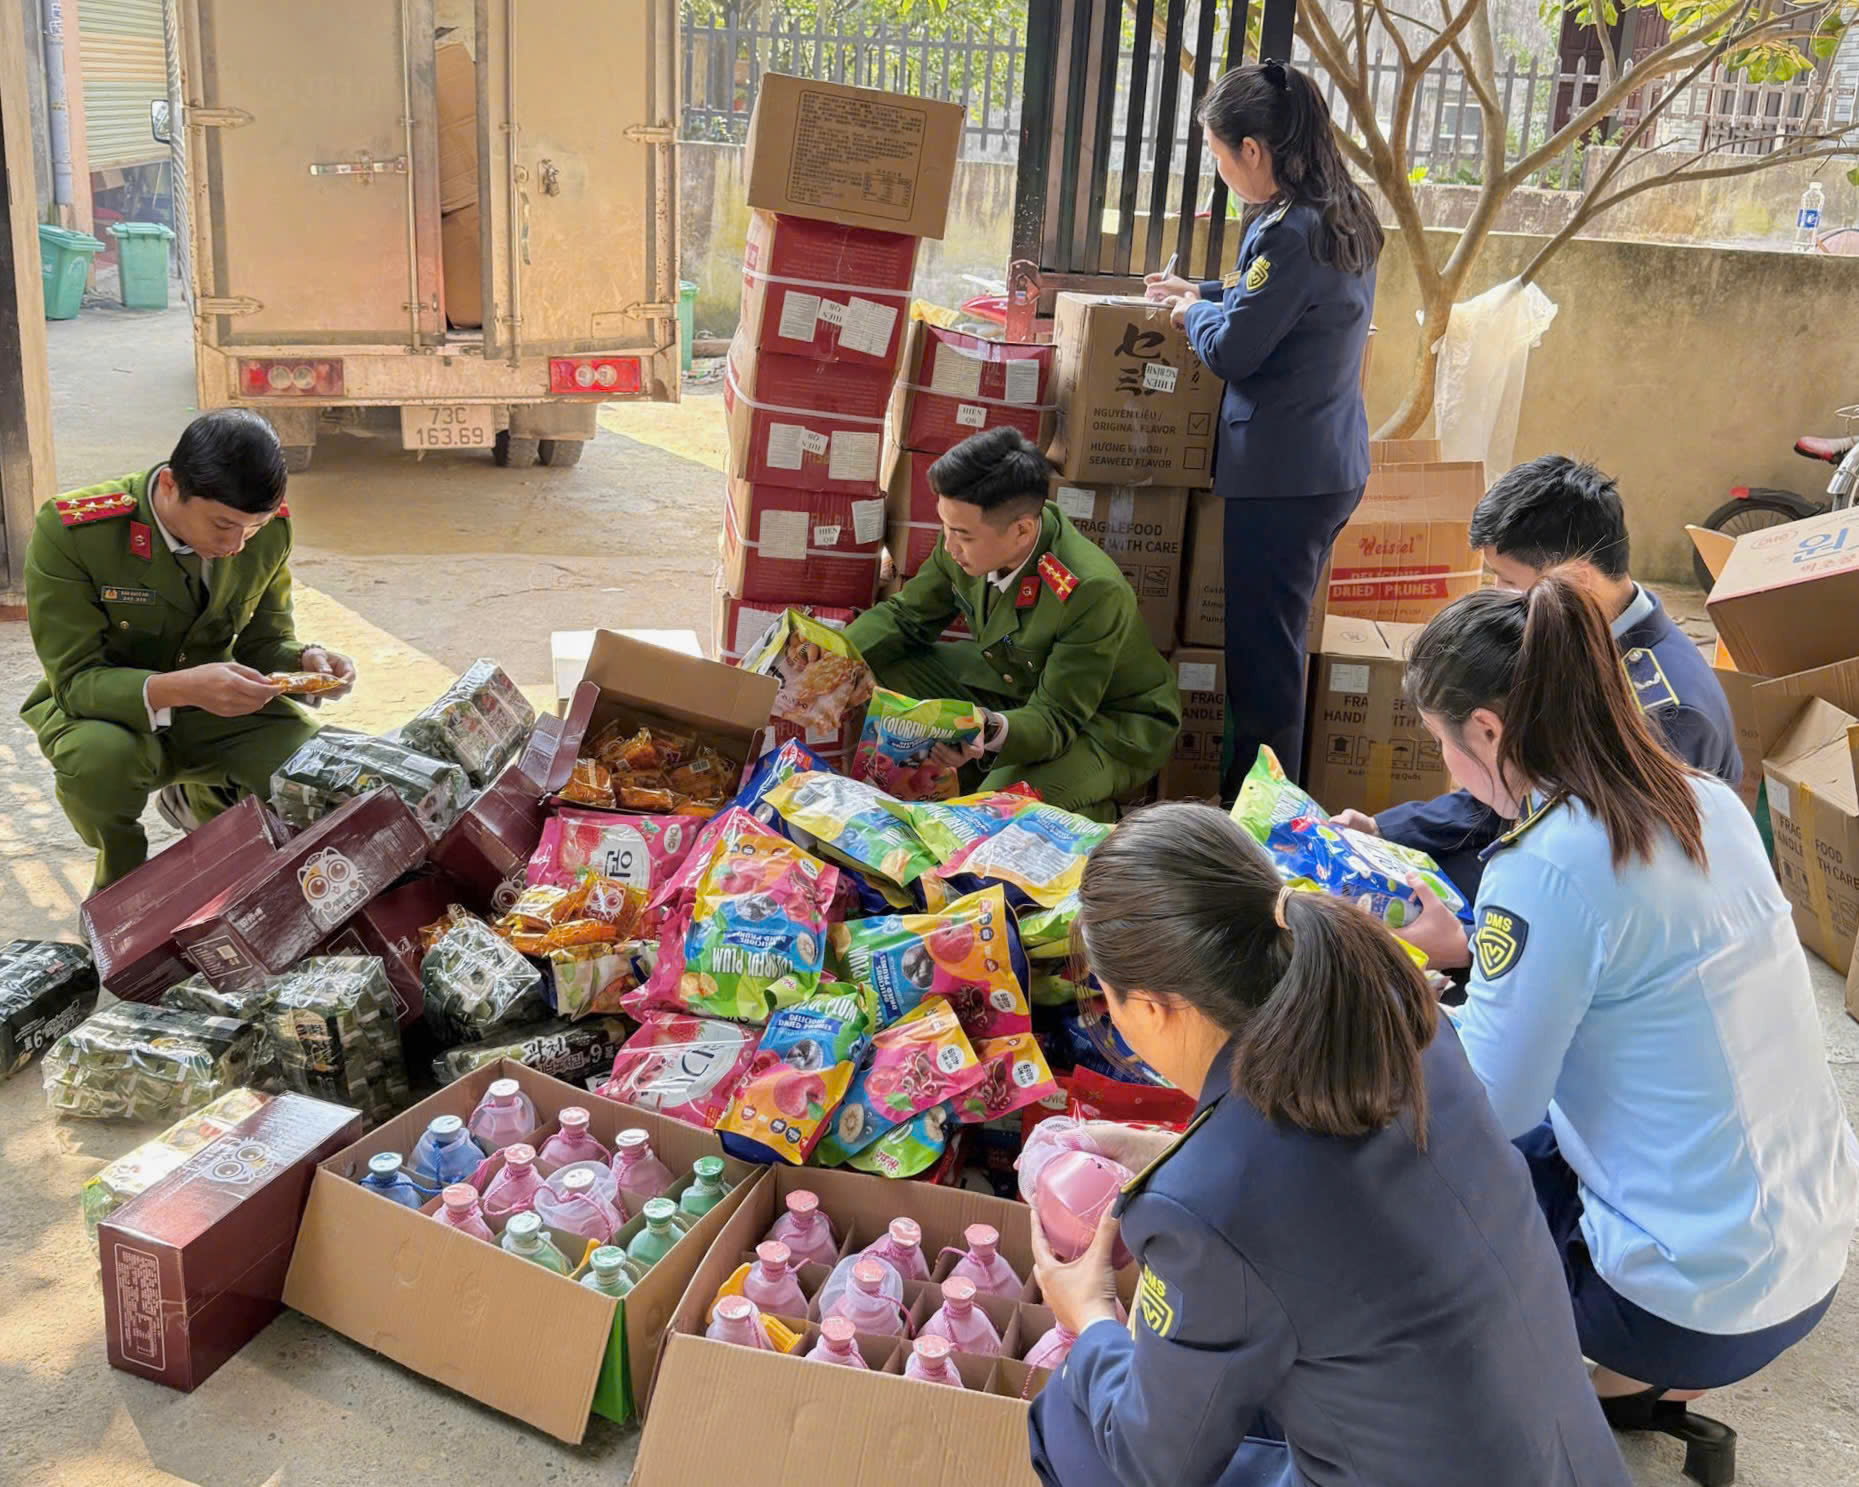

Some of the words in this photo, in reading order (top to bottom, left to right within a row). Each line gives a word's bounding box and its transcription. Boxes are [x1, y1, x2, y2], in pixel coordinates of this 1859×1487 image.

[428, 406, 467, 425] 73C
[416, 427, 484, 446] 163.69
[1088, 455, 1134, 467] SEAWEED
[1135, 458, 1172, 469] FLAVOR
[1145, 540, 1179, 554] CARE
[1332, 585, 1375, 598] DRIED
[1383, 583, 1438, 597] PRUNES
[1181, 707, 1224, 720] ANDLE
[882, 715, 927, 739] COLORFUL
[1815, 839, 1844, 865] FOOD
[1485, 911, 1513, 933] DMS
[711, 946, 745, 976] PLUM
[589, 1043, 601, 1063] 9
